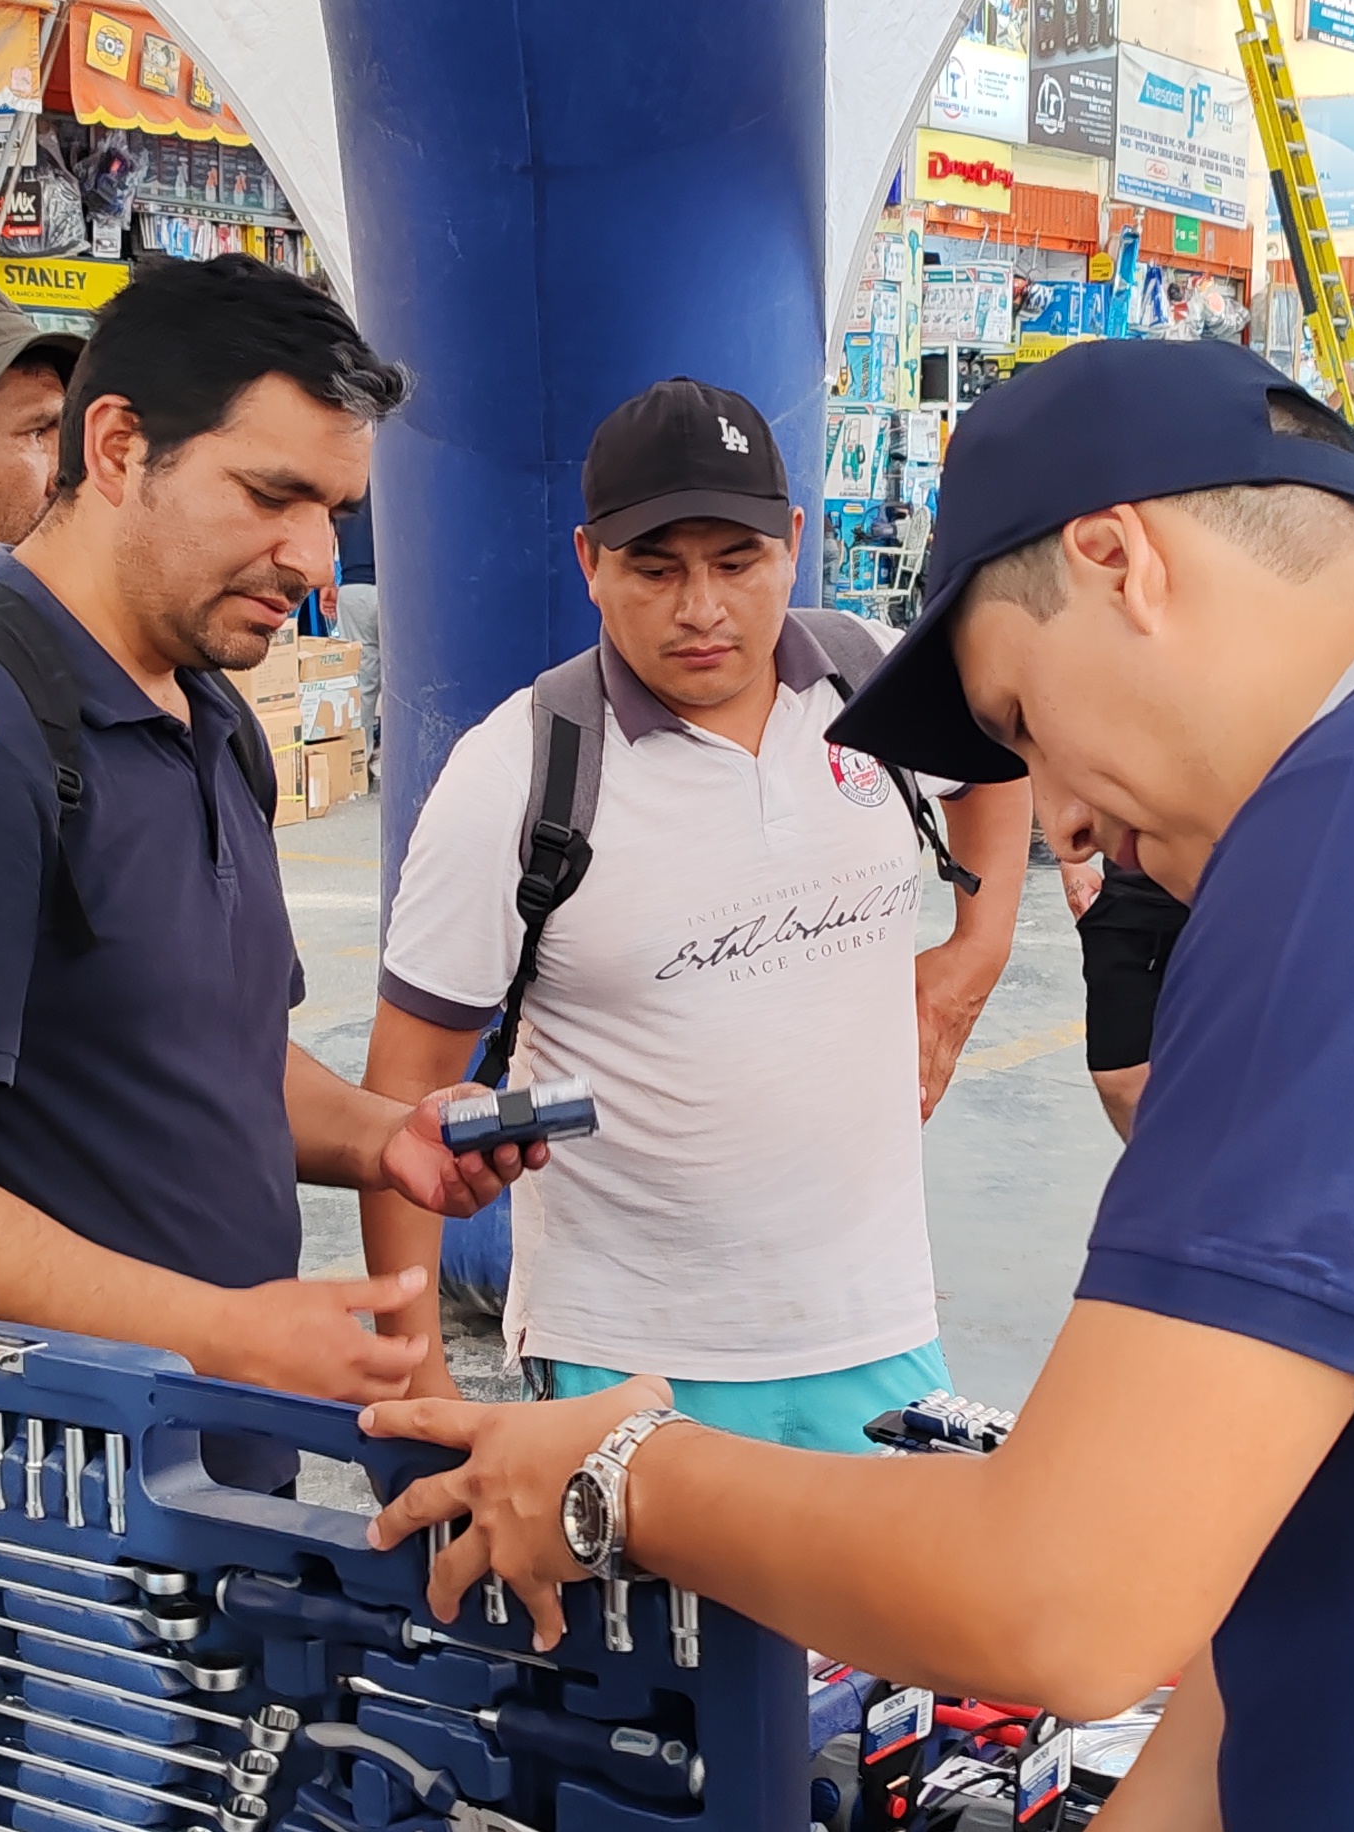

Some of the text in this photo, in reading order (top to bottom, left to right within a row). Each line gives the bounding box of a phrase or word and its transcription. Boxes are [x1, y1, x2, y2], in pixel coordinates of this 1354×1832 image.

[4, 264, 87, 290] STANLEY
[1019, 349, 1059, 359] STANLE
[717, 416, 749, 454] LA
[751, 879, 822, 908] MEMBER
[832, 856, 905, 886] NEWPORT
[728, 927, 887, 983] RACE COURSE
